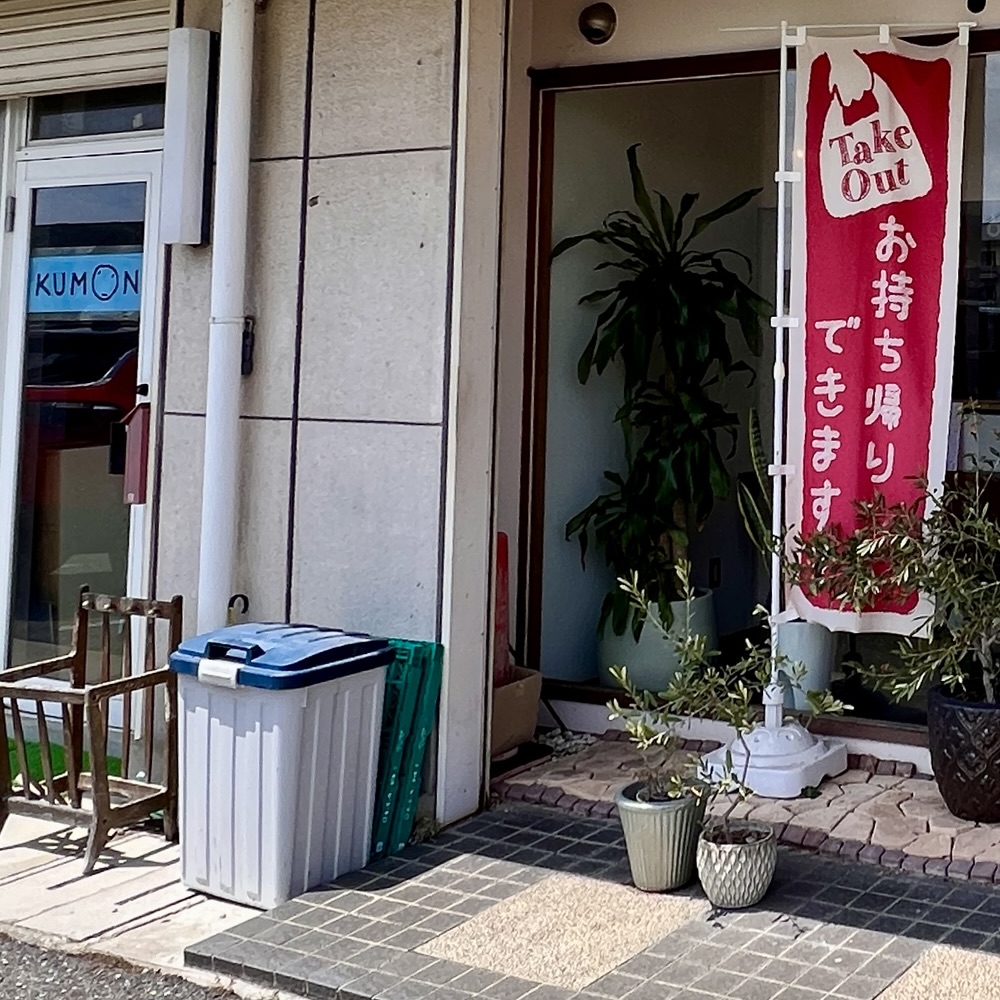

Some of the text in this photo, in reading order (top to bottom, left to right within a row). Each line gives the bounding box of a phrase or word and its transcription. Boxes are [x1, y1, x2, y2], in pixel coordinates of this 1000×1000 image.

[828, 119, 913, 168] Take
[840, 157, 911, 203] Out
[35, 263, 140, 301] KUMON
[864, 214, 917, 484] お持ち帰り
[809, 315, 861, 532] できます
